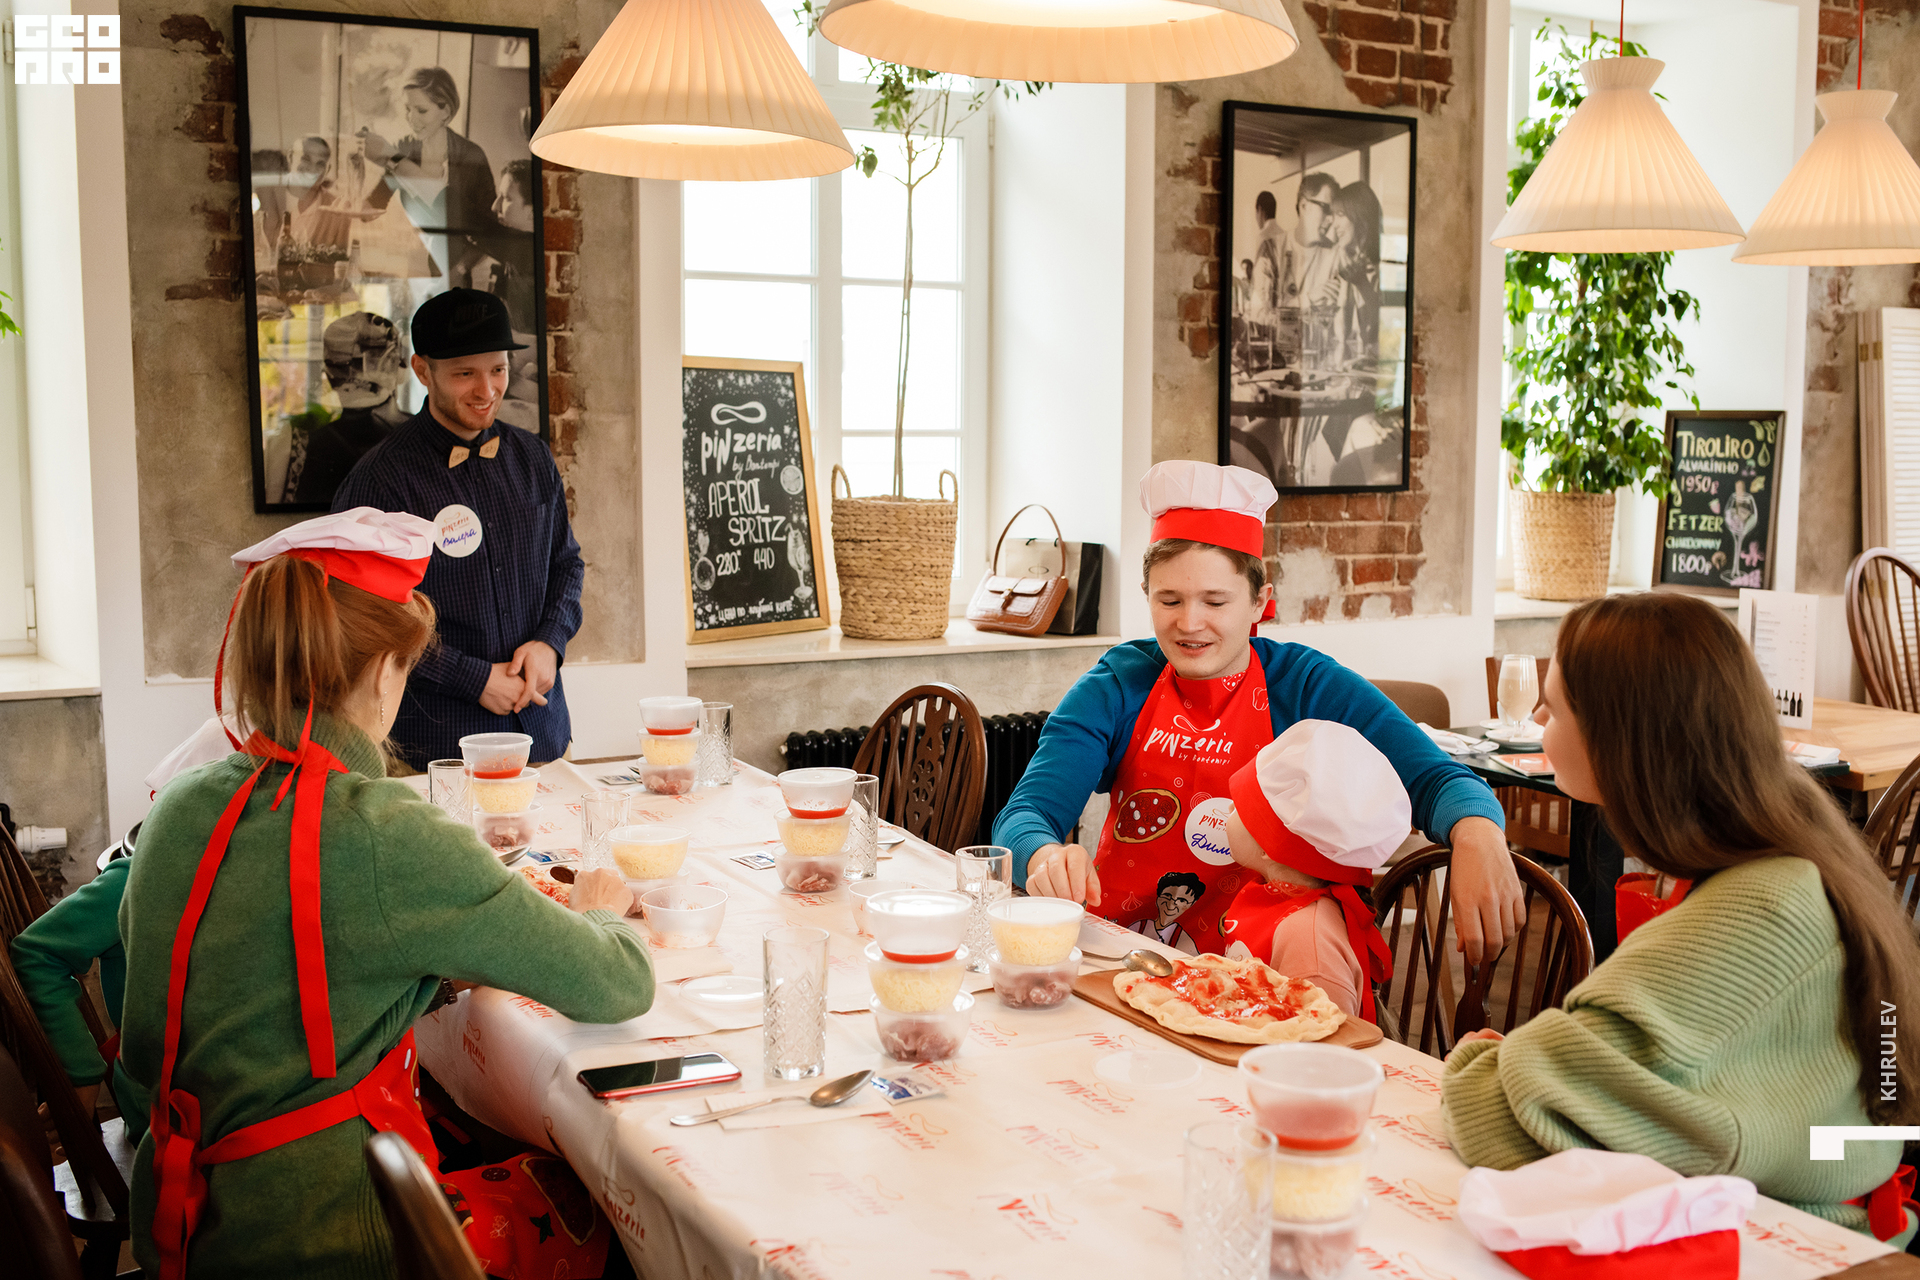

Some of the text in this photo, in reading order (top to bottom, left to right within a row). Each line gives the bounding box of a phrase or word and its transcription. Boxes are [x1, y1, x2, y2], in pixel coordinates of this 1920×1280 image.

[732, 455, 744, 480] by
[708, 477, 770, 518] APEROL
[728, 515, 787, 546] SPRITZ
[1667, 508, 1725, 533] FETZER
[754, 547, 775, 570] 440
